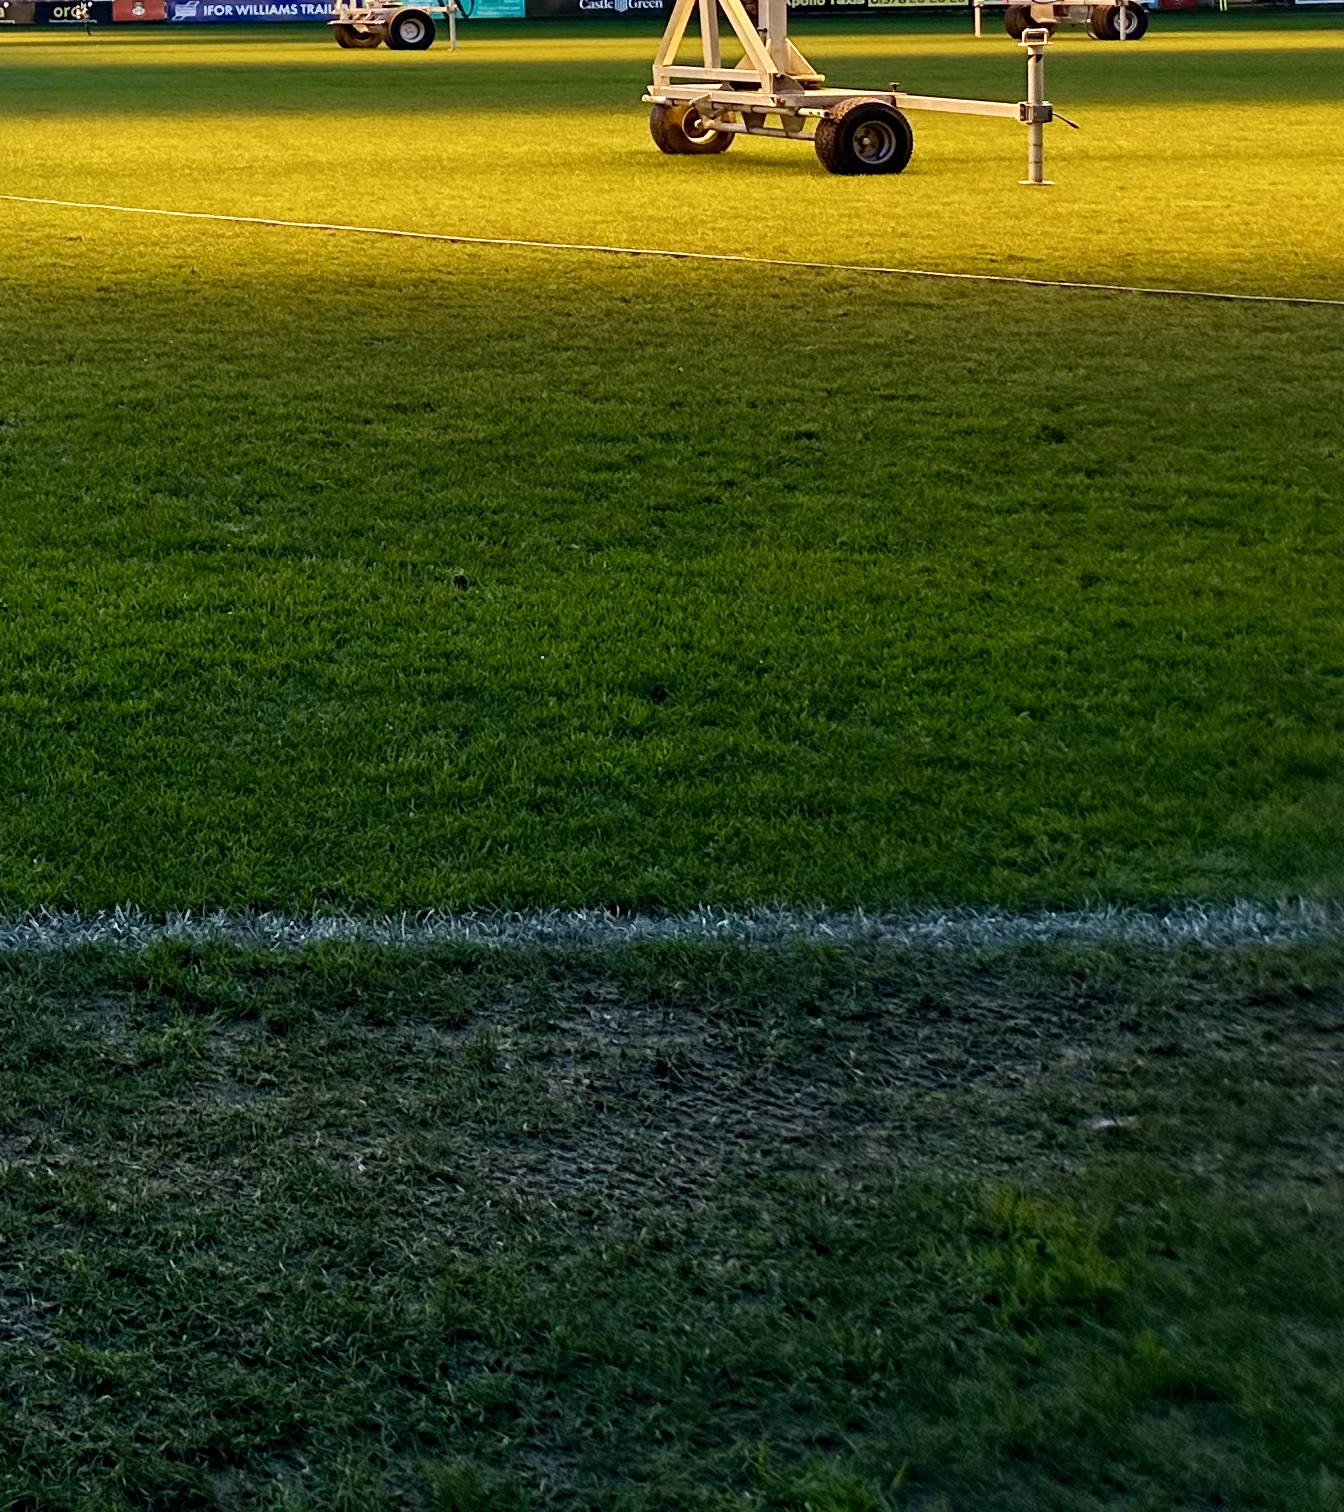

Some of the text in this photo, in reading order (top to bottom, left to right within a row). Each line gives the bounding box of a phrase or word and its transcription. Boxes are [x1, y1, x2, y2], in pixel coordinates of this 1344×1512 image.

[203, 2, 348, 16] IFOR WILLIAMS TRAIL
